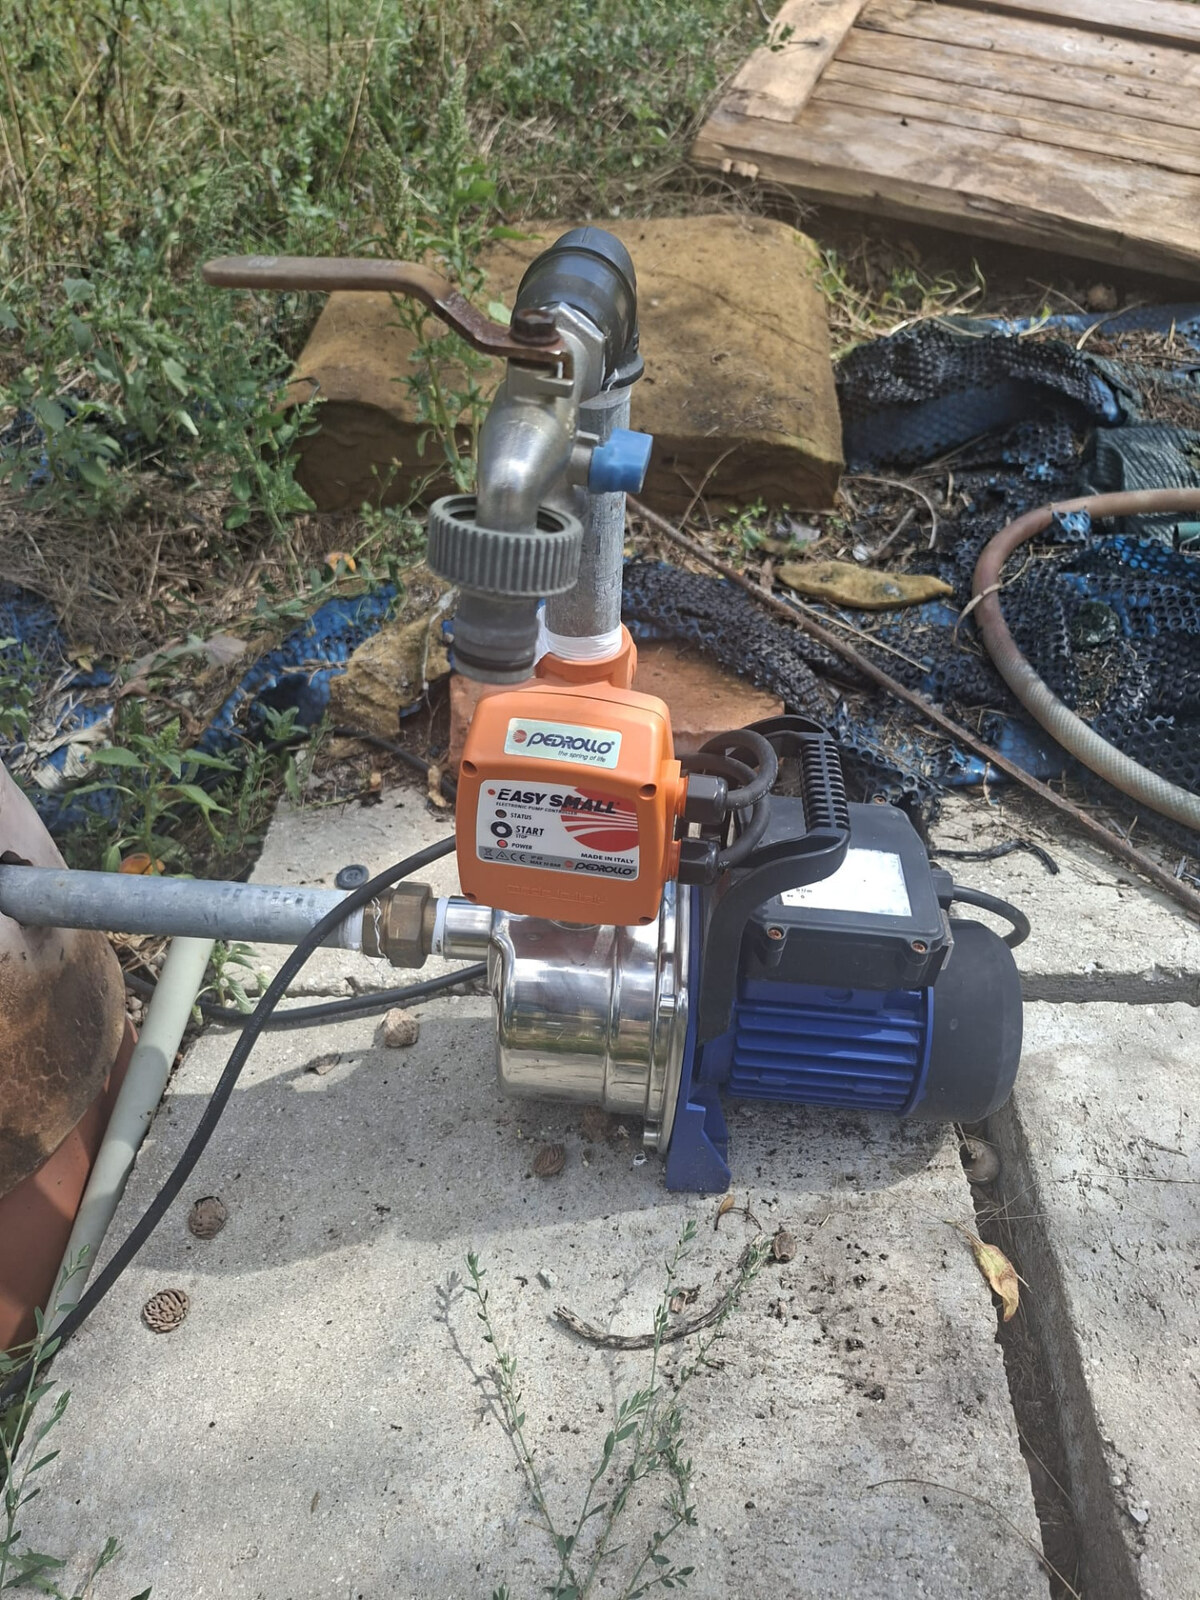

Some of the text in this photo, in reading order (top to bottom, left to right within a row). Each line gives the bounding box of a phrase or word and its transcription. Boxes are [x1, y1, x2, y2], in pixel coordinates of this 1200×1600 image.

[569, 752, 589, 761] spring
[597, 755, 606, 763] life
[496, 801, 527, 810] ELECTRONIC
[497, 788, 617, 814] EASY SMALL
[511, 812, 532, 820] STATUS
[515, 825, 544, 836] START
[511, 842, 532, 850] POWER
[581, 852, 604, 861] MADE
